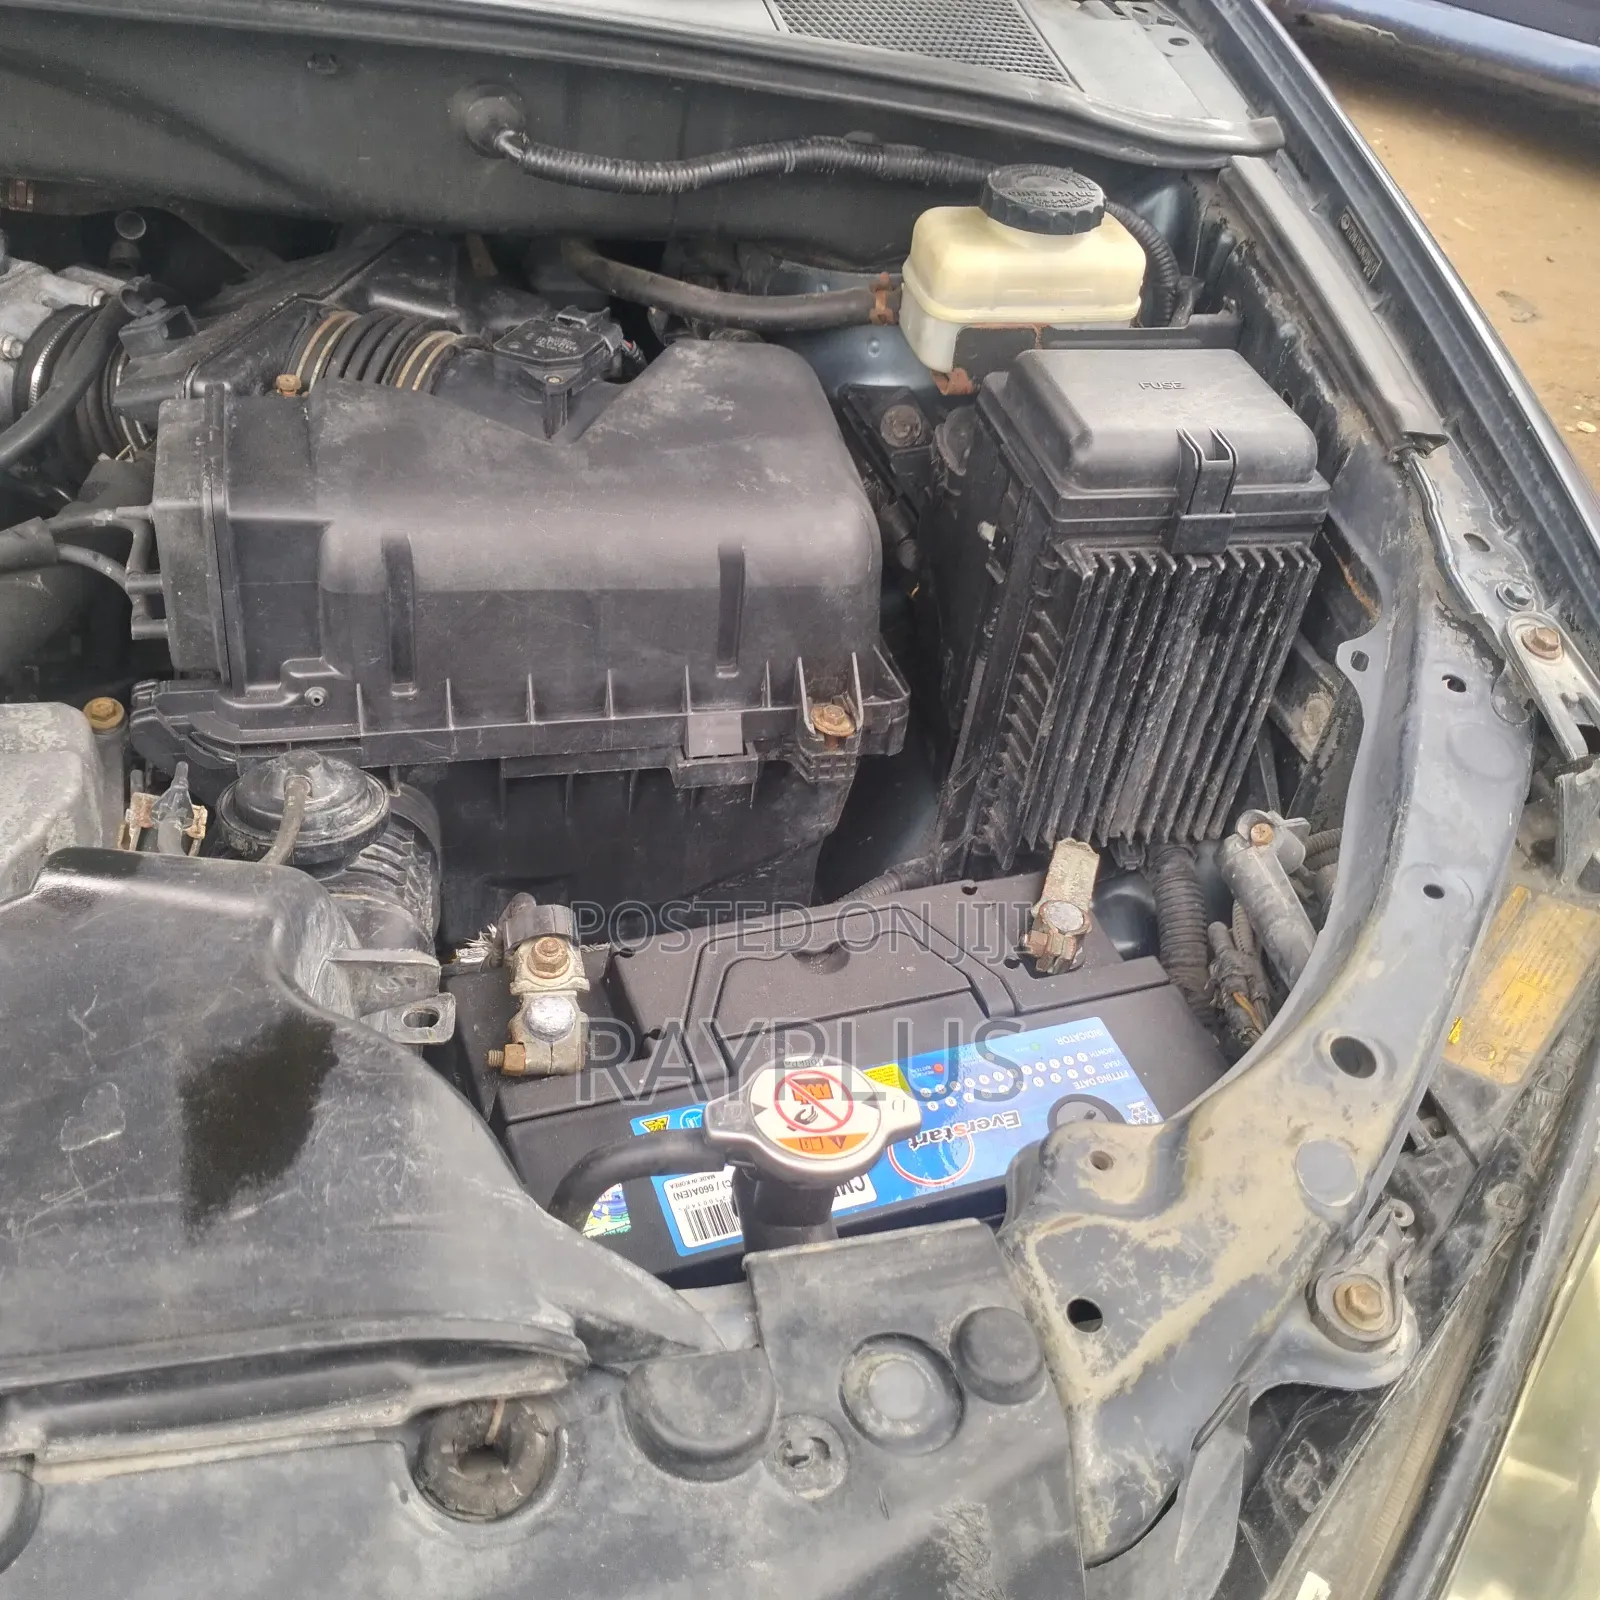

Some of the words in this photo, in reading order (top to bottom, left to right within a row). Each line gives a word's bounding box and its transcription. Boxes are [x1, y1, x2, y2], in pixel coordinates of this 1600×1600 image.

[1139, 381, 1184, 390] FUSE
[1055, 1028, 1105, 1045] INDICATOR
[1089, 1047, 1116, 1058] MONTH
[1102, 1059, 1121, 1070] YEAR
[1073, 1076, 1100, 1090] DATE
[1099, 1070, 1130, 1084] FITTING
[909, 1110, 1021, 1151] Everstart
[669, 1180, 691, 1189] KOREA
[673, 1183, 715, 1201] 660A(EN)
